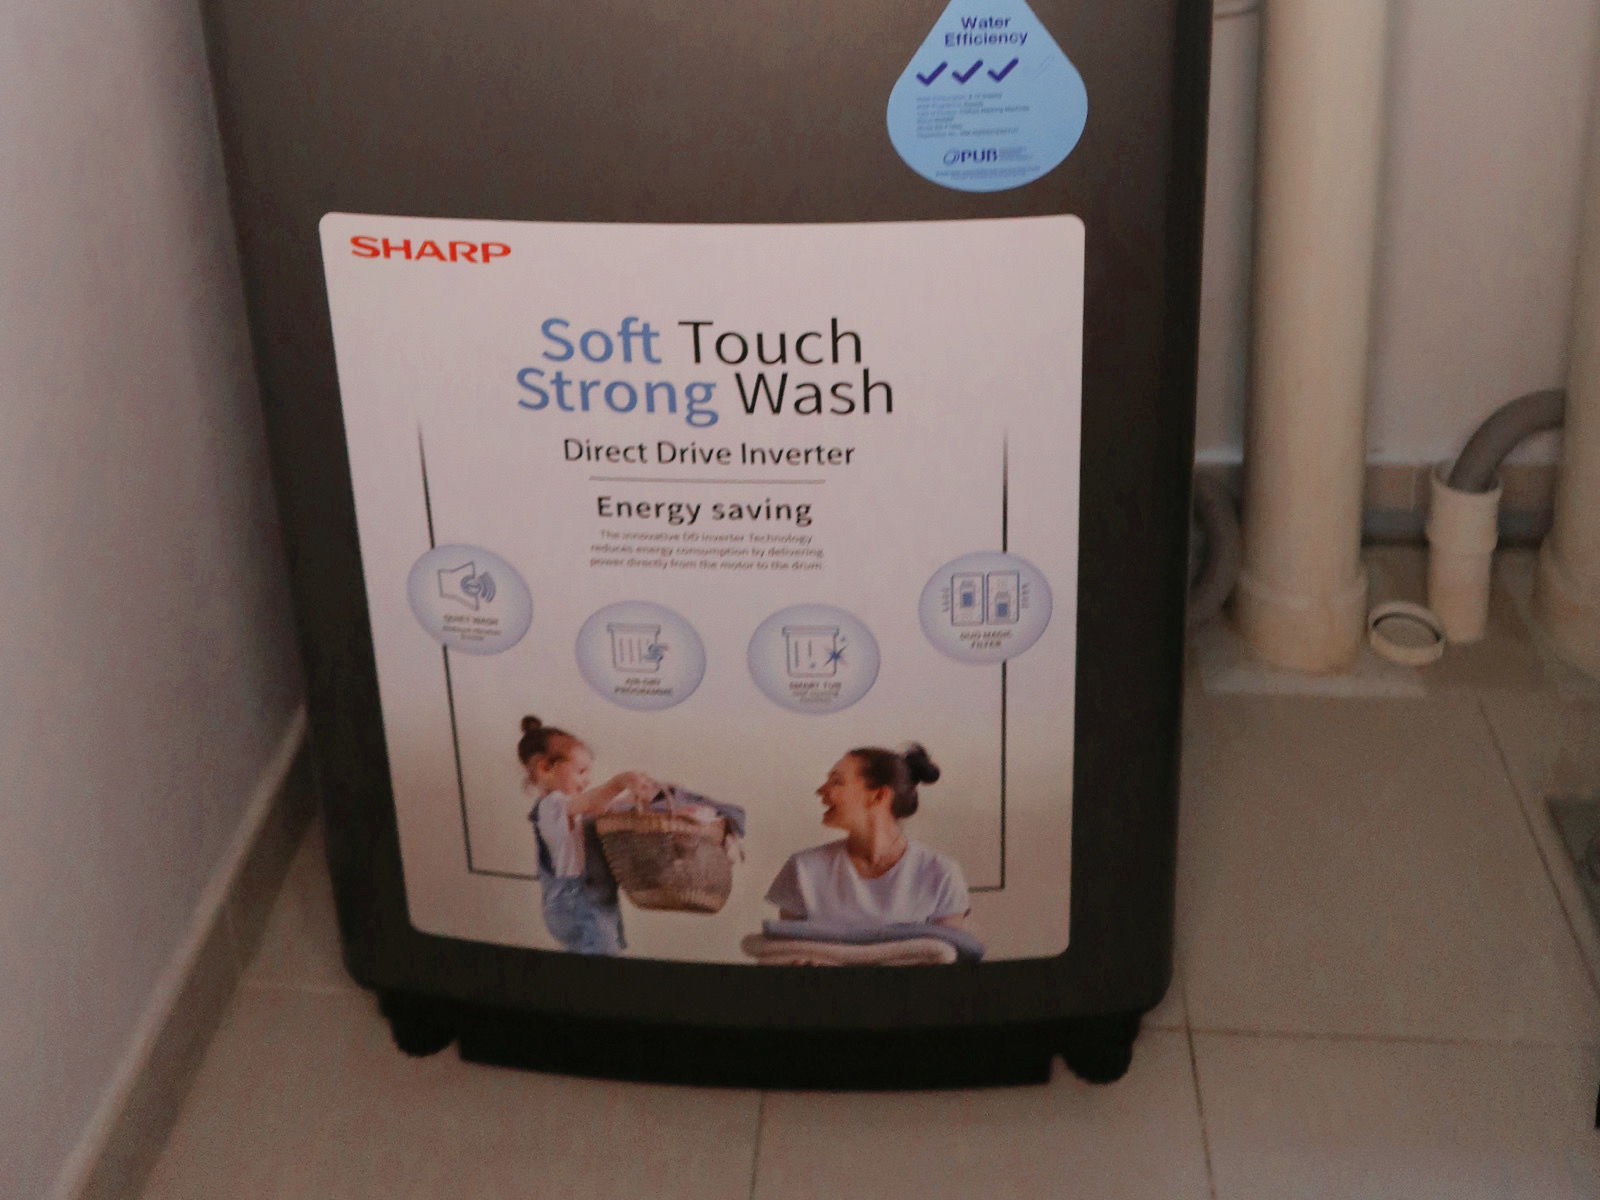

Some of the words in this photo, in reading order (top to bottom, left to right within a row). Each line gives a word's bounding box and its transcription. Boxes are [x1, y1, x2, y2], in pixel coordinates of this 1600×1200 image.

[961, 16, 1012, 29] Water
[945, 32, 1028, 47] Efficiency
[960, 149, 998, 163] PUB
[350, 236, 512, 264] SHARP
[541, 316, 662, 365] Soft
[678, 317, 862, 366] Touch
[517, 367, 719, 428] Strong
[735, 369, 894, 416] Wash
[564, 439, 648, 463] Direct
[657, 440, 732, 465] Drive
[741, 442, 855, 466] Inverter
[597, 496, 701, 526] Energy
[712, 498, 813, 527] saving
[600, 529, 620, 540] The
[751, 547, 766, 558] by
[699, 559, 718, 569] the
